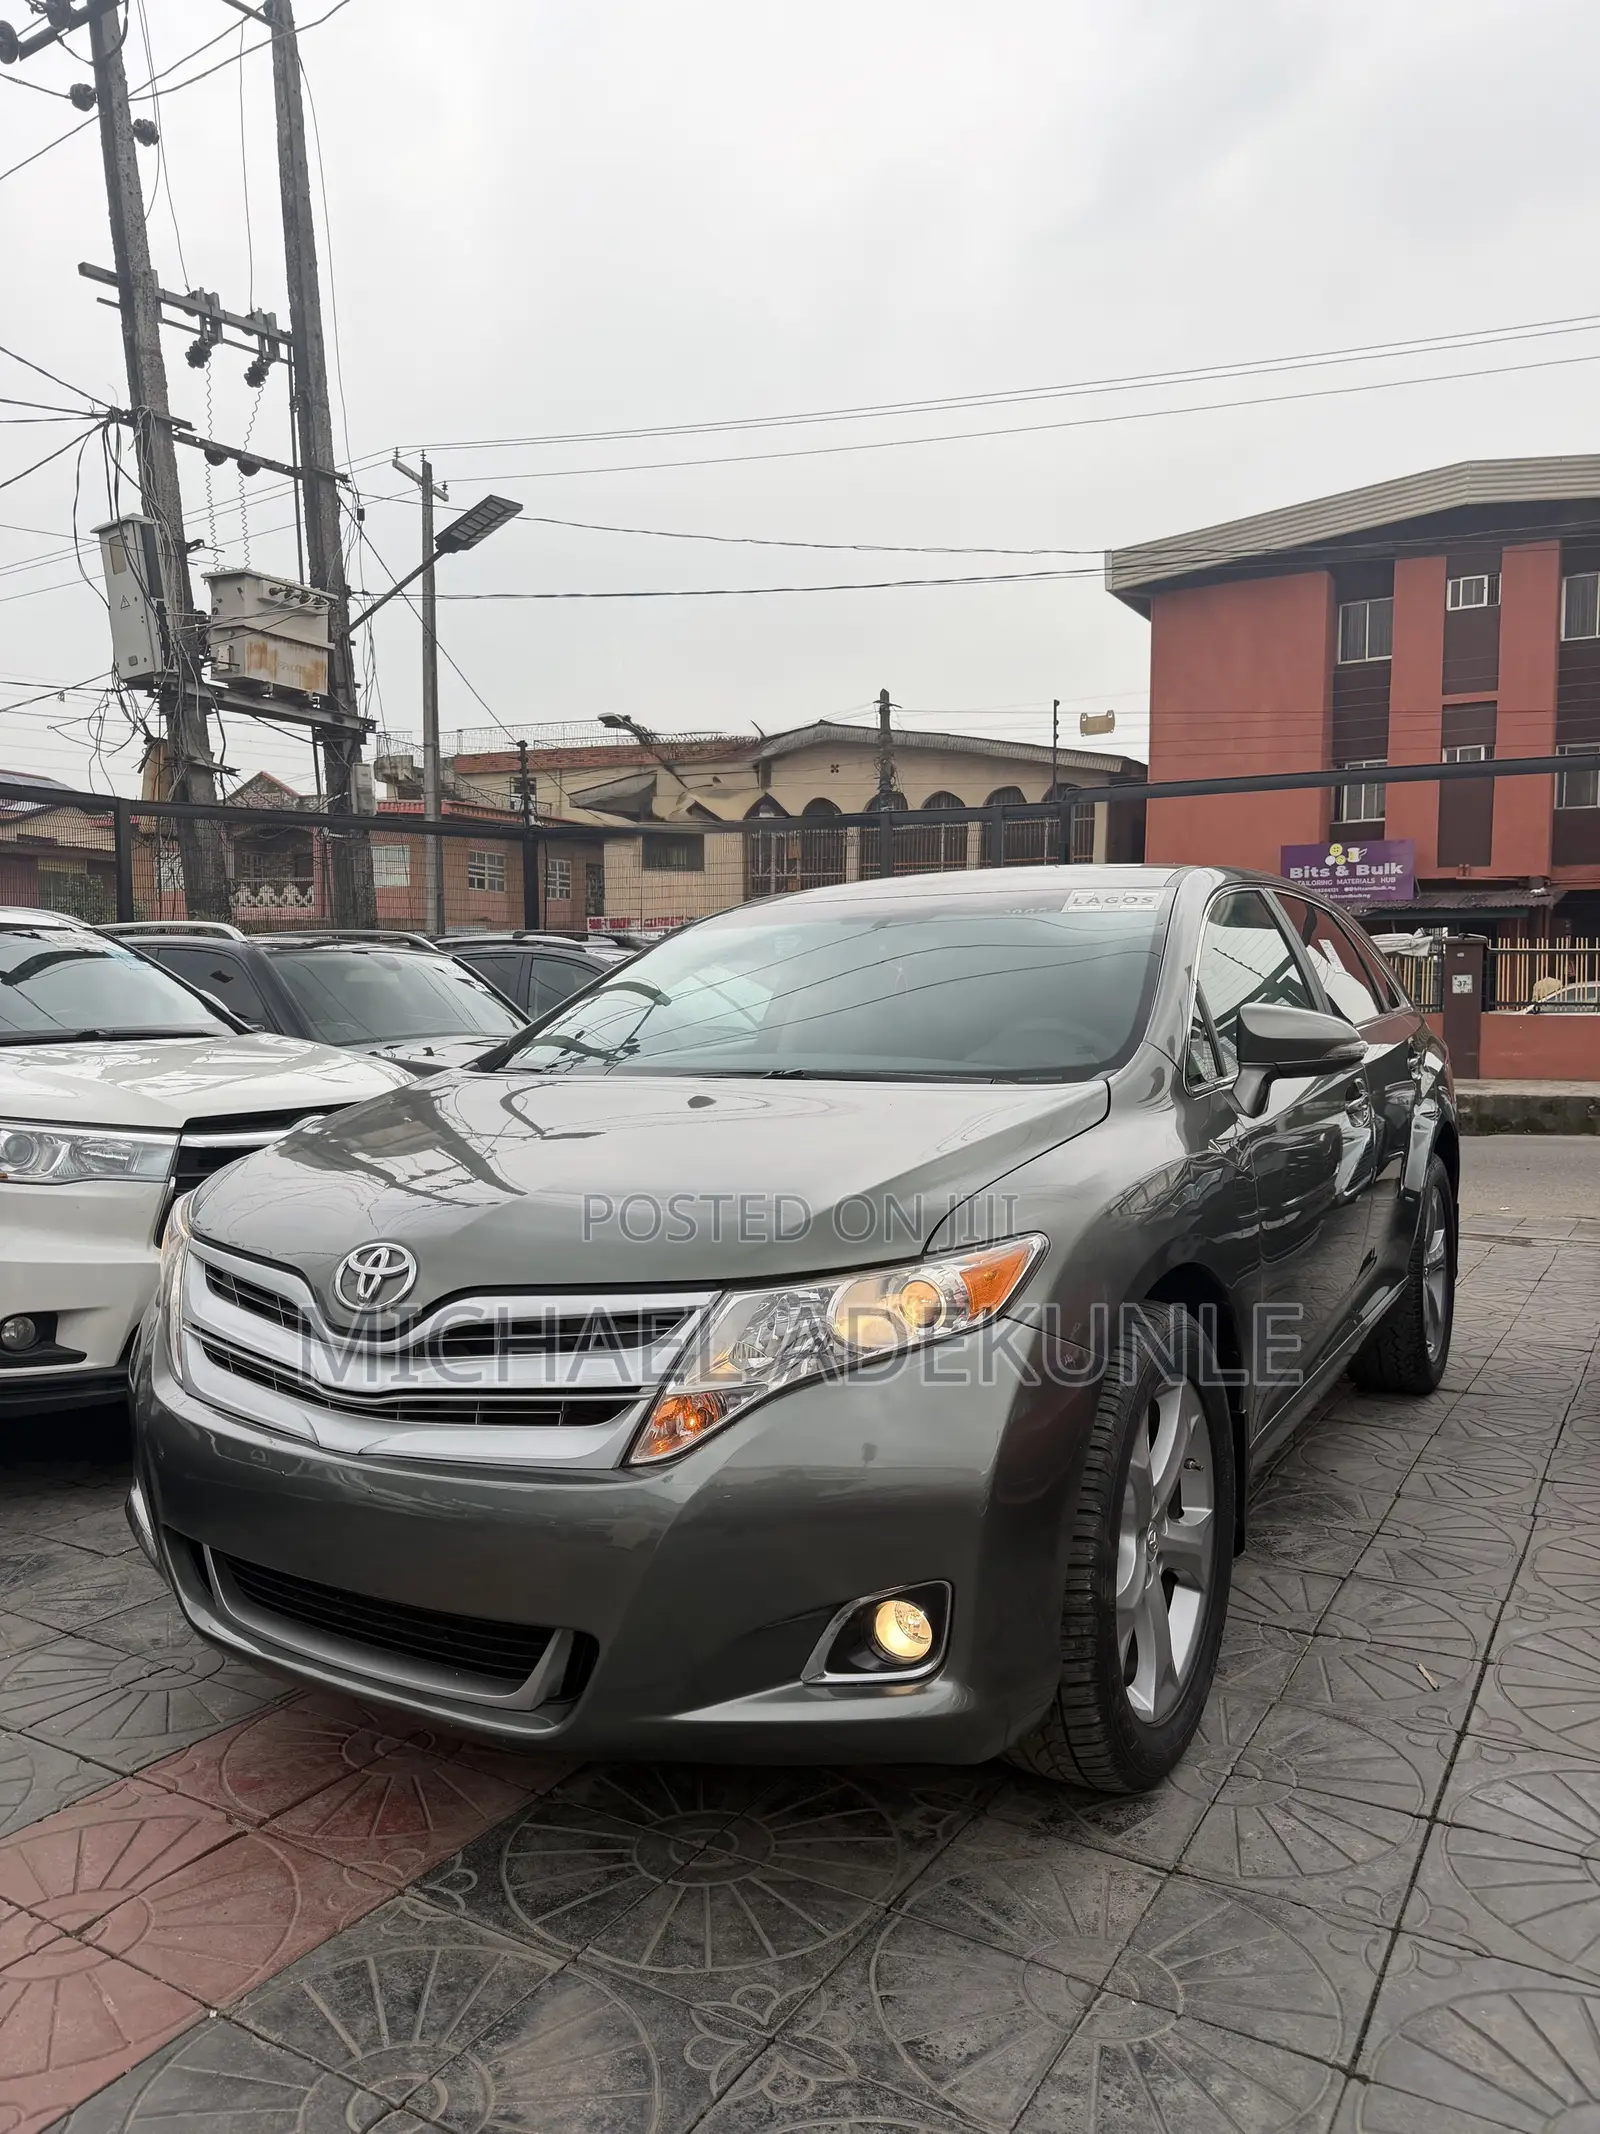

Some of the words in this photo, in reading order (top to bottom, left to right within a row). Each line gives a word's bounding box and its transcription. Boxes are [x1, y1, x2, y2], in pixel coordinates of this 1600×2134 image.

[1289, 865, 1330, 879] Bits
[1335, 866, 1349, 877] &
[1356, 863, 1403, 876] Bulk
[1297, 879, 1333, 887] TAILORING
[1337, 877, 1376, 886] MATERIALS
[1380, 876, 1396, 884] HUB
[1072, 896, 1155, 905] LAGOS
